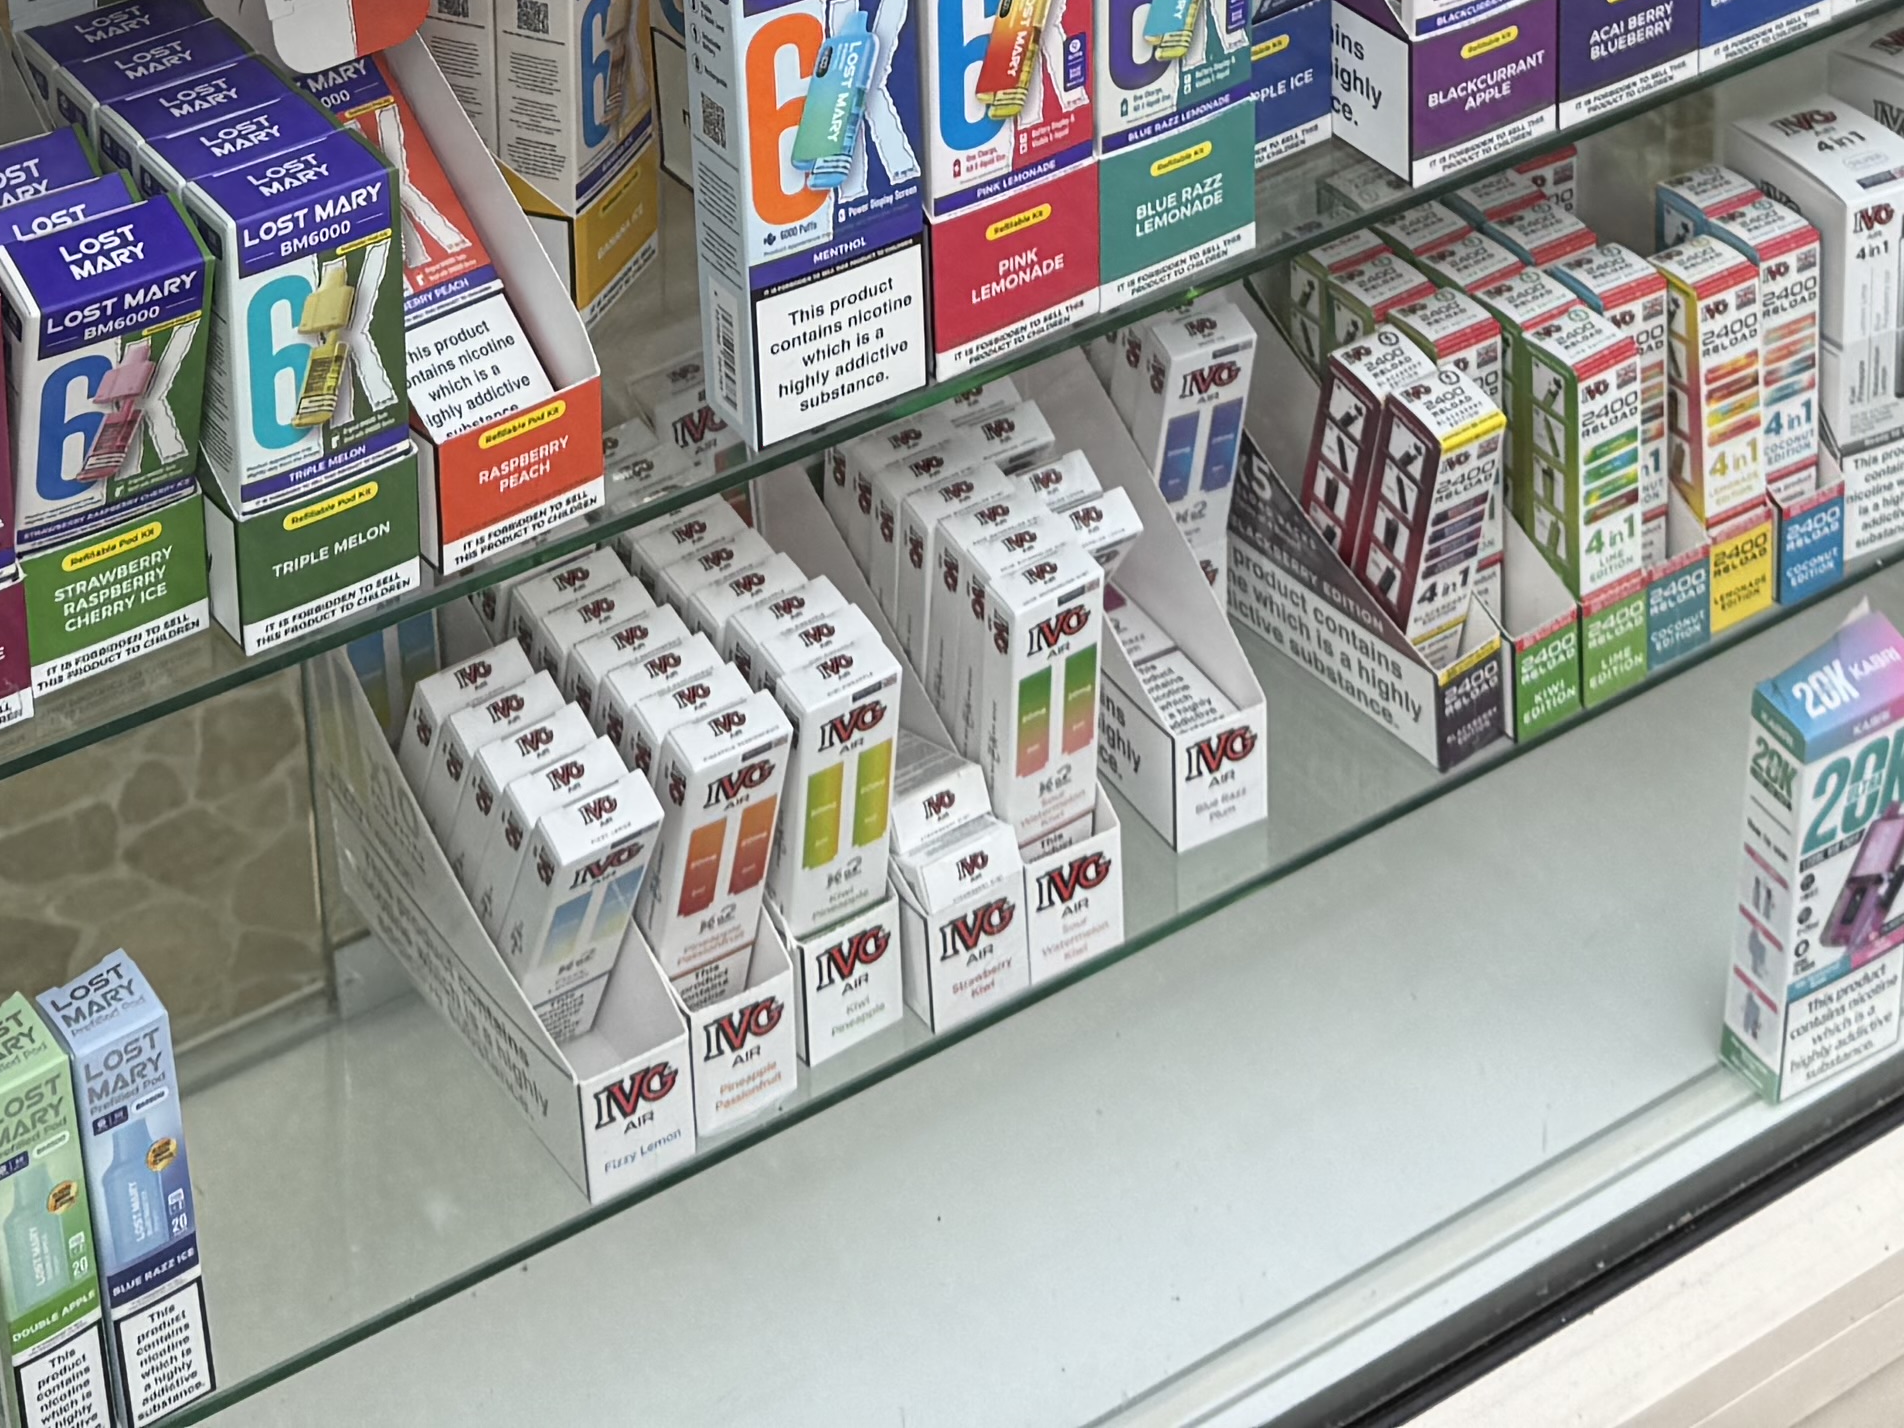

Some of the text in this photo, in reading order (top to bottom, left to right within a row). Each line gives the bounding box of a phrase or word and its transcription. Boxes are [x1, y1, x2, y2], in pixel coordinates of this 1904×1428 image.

[1429, 51, 1544, 107] BLACKCURRANT
[1466, 82, 1511, 110] APPLE
[814, 237, 867, 263] MENTHOL
[999, 248, 1037, 275] PINK
[972, 256, 1064, 303] LEMONADE
[479, 437, 568, 483] RASPBERRY
[500, 462, 549, 492] PEACH
[1524, 686, 1575, 724] EDITION
[1535, 679, 1564, 704] KIWI
[1792, 658, 1860, 719] 20K
[939, 897, 1015, 959] IVG
[967, 944, 993, 966] AIR
[594, 1062, 678, 1127] IVG
[624, 1111, 653, 1134] AIR
[13, 1290, 95, 1342] DOUBLE APPLE
